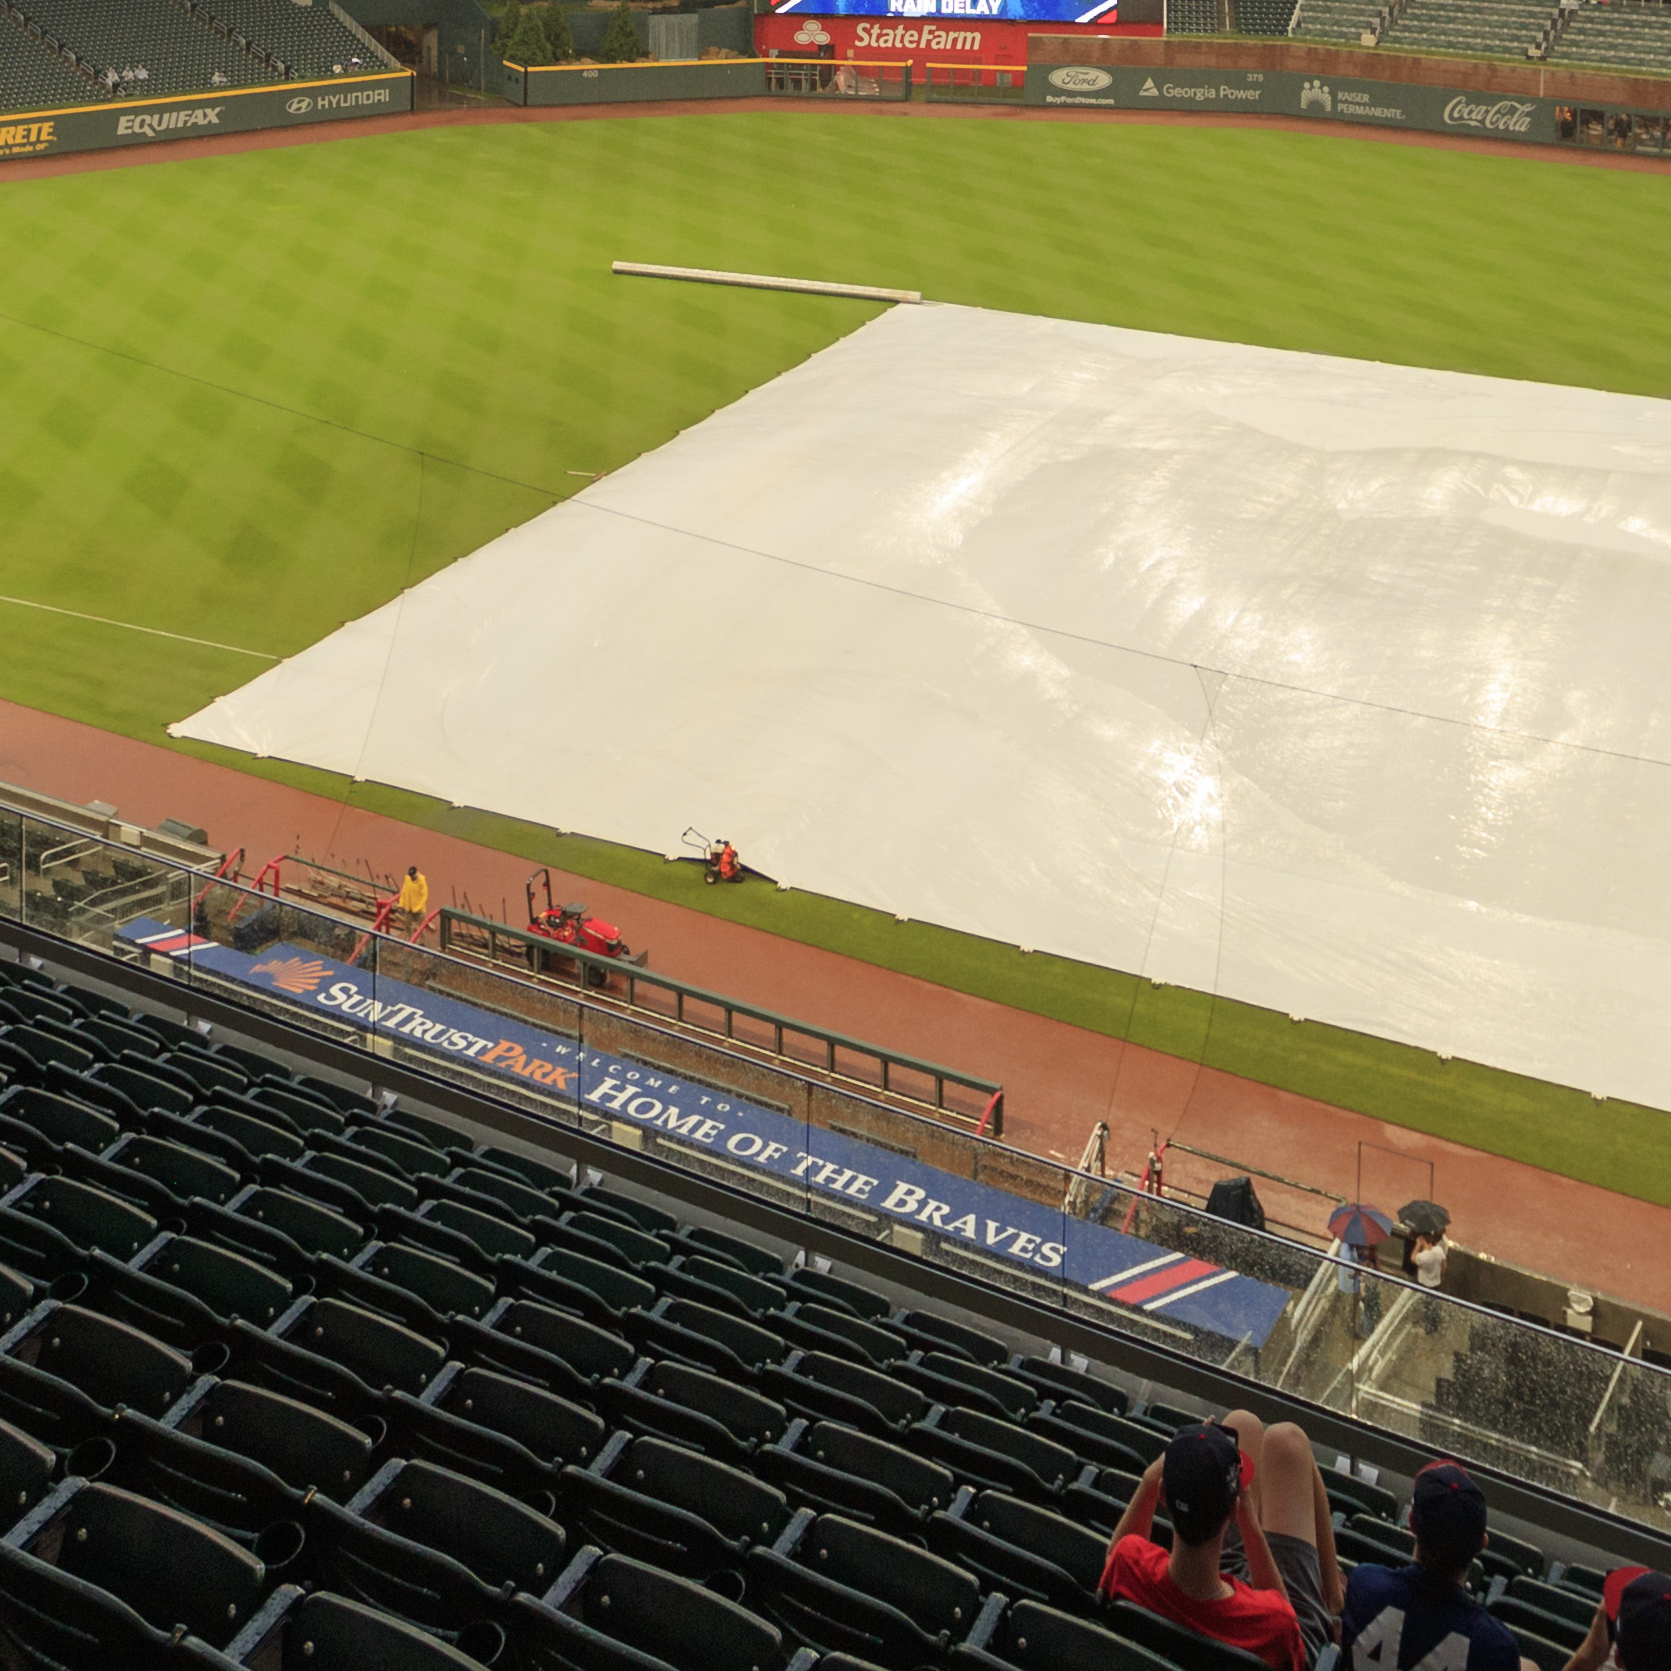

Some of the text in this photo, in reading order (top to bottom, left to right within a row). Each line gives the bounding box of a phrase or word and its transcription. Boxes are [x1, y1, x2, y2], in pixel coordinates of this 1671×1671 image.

[1061, 70, 1099, 87] Ford
[1246, 73, 1264, 82] 375
[317, 89, 390, 111] HYUNDAI
[1045, 94, 1115, 106] BuyFordNow.com
[1163, 83, 1262, 101] Georgia Power
[1337, 91, 1370, 104] KAISER
[1337, 103, 1403, 120] PERMANENTE
[117, 106, 222, 137] EQUIFAX
[12, 144, 33, 155] Made
[700, 1094, 732, 1112] TO
[585, 1075, 1068, 1269] HOME OF THE BRAVES
